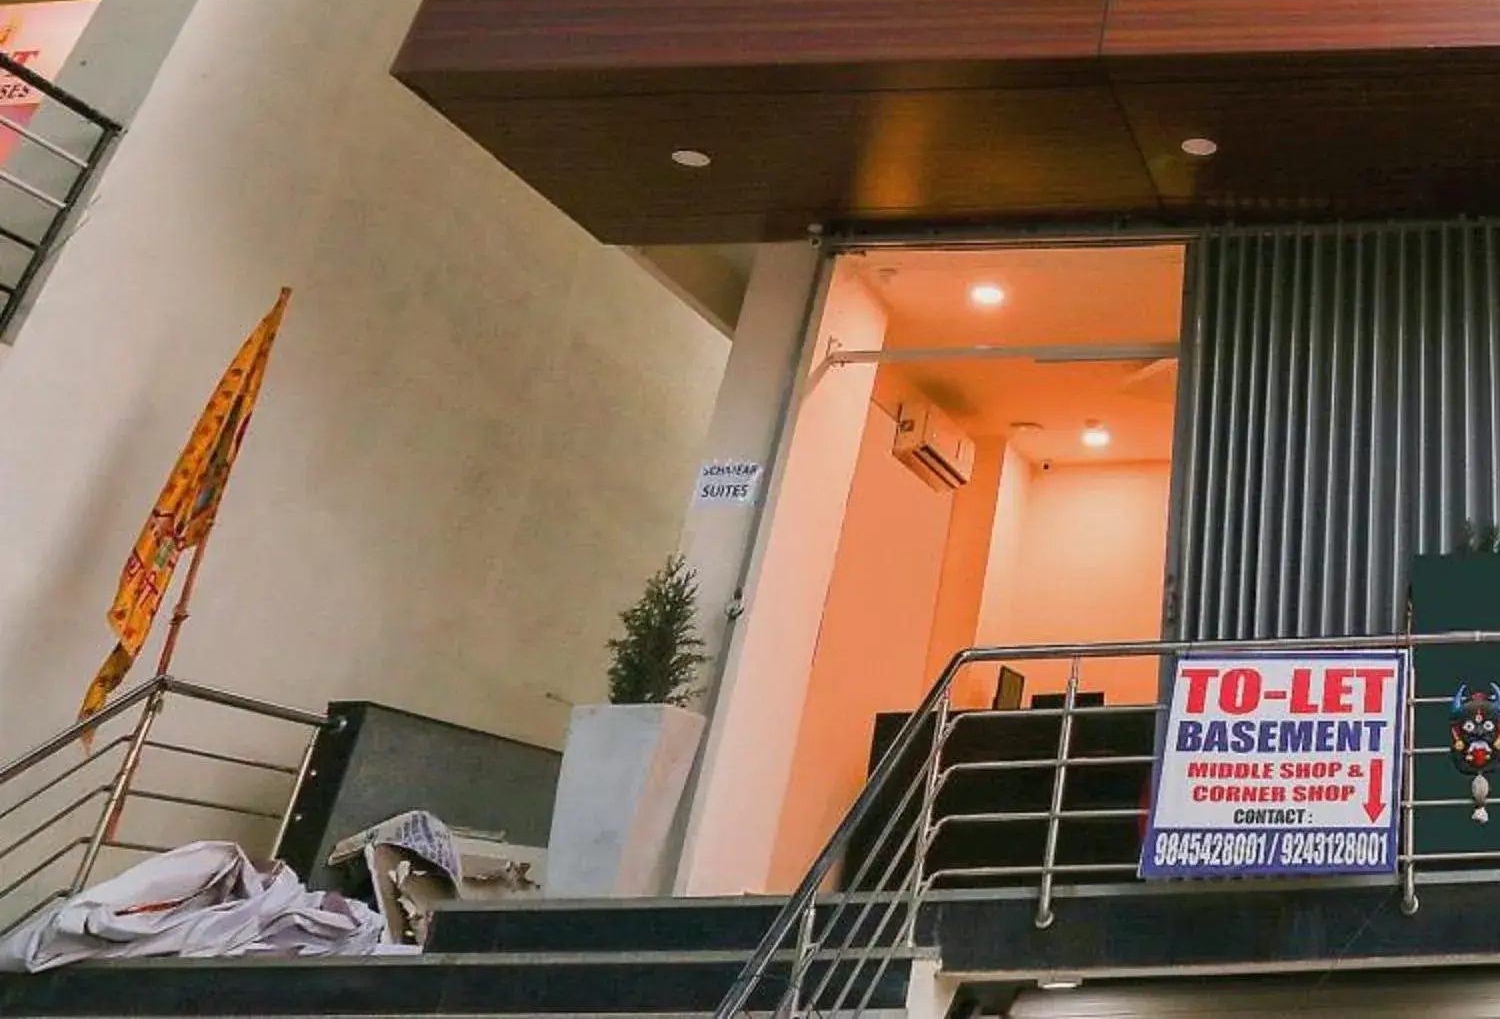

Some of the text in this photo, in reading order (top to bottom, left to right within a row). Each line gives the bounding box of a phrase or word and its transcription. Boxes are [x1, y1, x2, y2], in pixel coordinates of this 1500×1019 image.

[701, 484, 748, 498] SUITES
[1180, 668, 1394, 714] TO-LET
[1176, 720, 1388, 753] BASEMENT
[1187, 762, 1274, 779] MIDDLE
[1280, 762, 1342, 779] SHOP
[1193, 785, 1356, 802] CORNER SHOP
